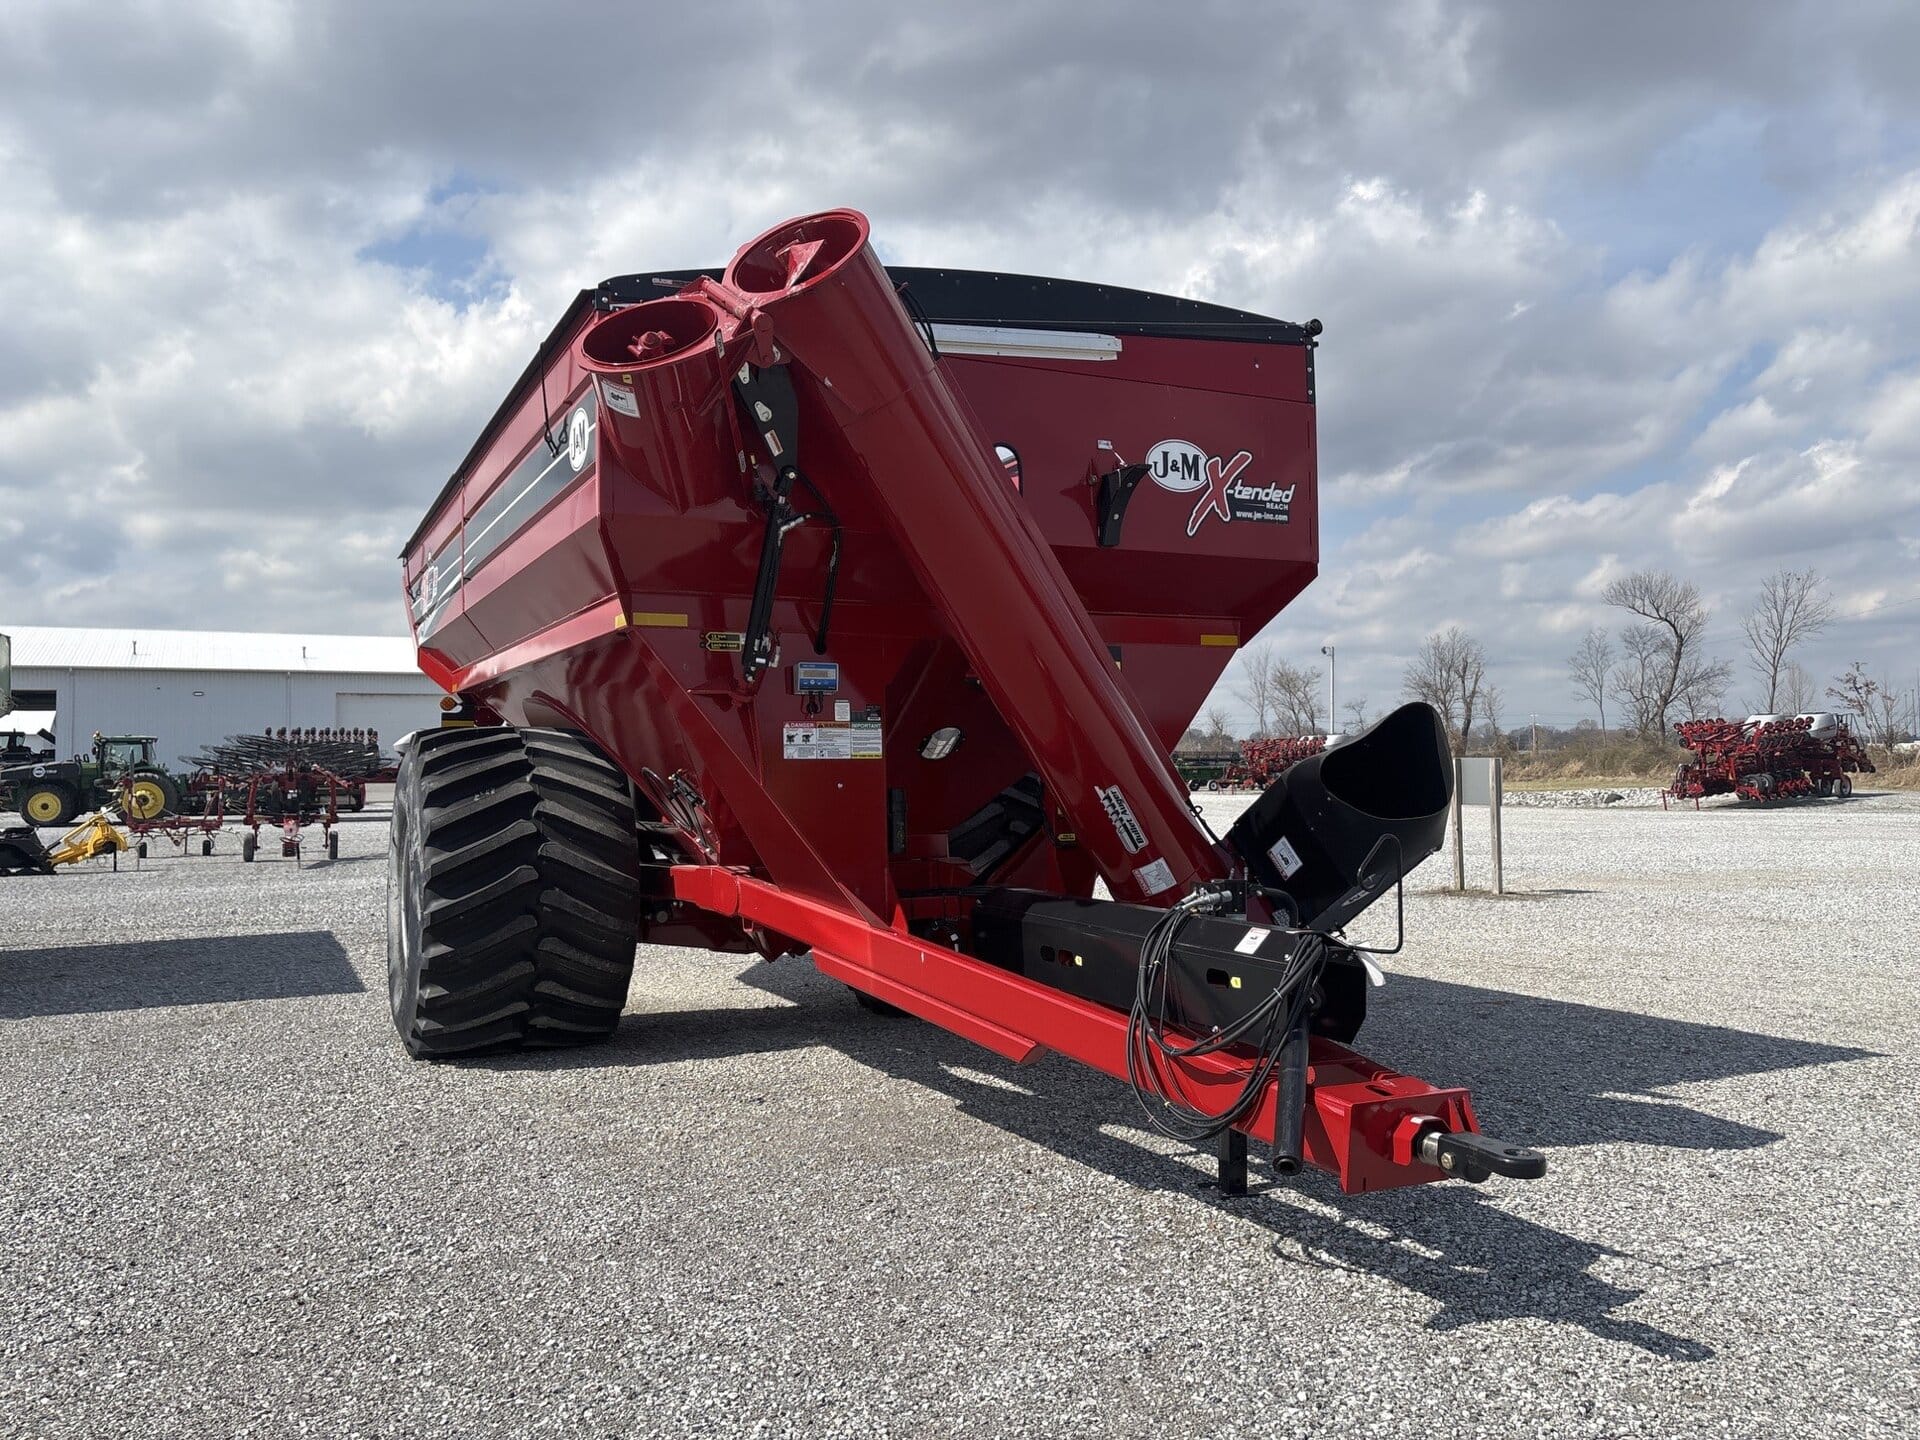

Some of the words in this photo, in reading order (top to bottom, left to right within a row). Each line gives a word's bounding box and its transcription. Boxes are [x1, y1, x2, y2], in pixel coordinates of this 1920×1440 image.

[1153, 451, 1201, 482] J&M
[1266, 502, 1289, 511] REACH
[1111, 790, 1130, 816] Auger
[1126, 819, 1145, 844] Bullet
